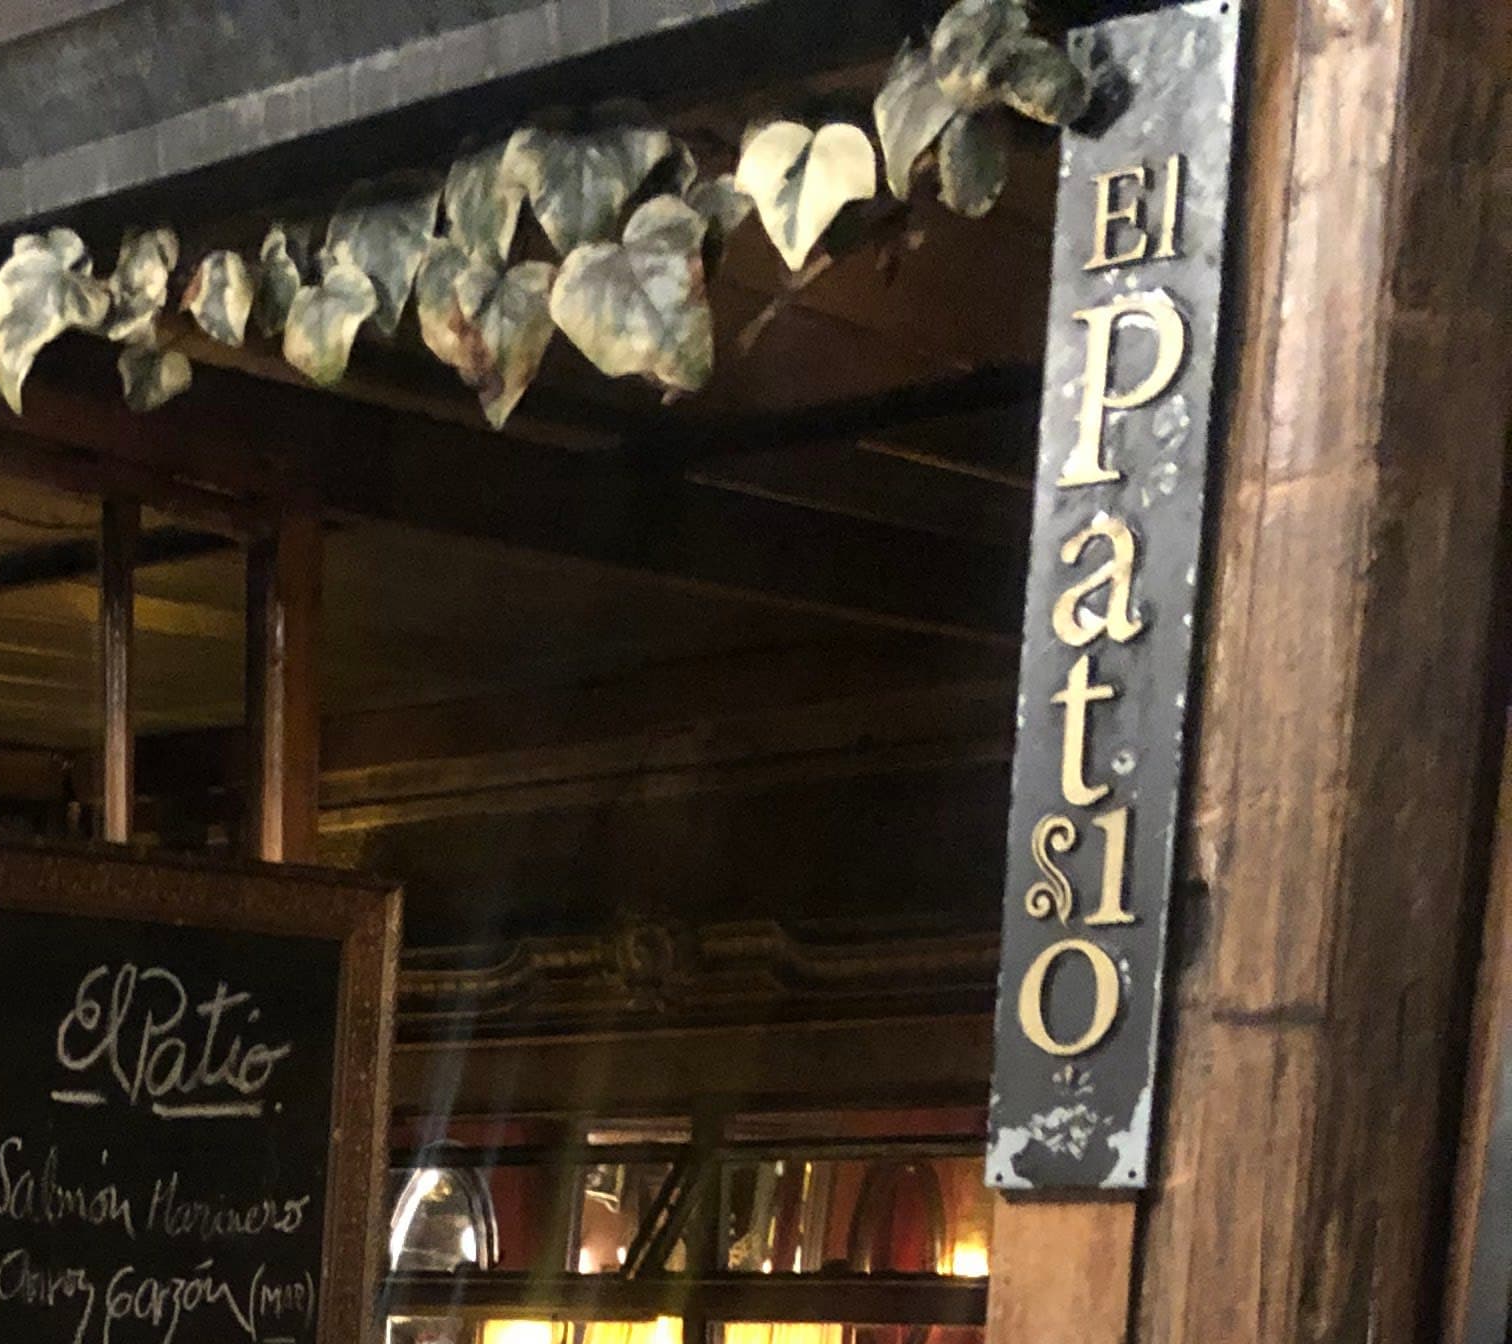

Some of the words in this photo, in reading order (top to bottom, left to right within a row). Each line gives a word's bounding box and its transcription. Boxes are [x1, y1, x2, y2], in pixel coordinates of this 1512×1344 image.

[1082, 152, 1180, 272] El
[1019, 287, 1186, 1059] Patio
[56, 963, 138, 1096] El
[129, 966, 291, 1106] Patio
